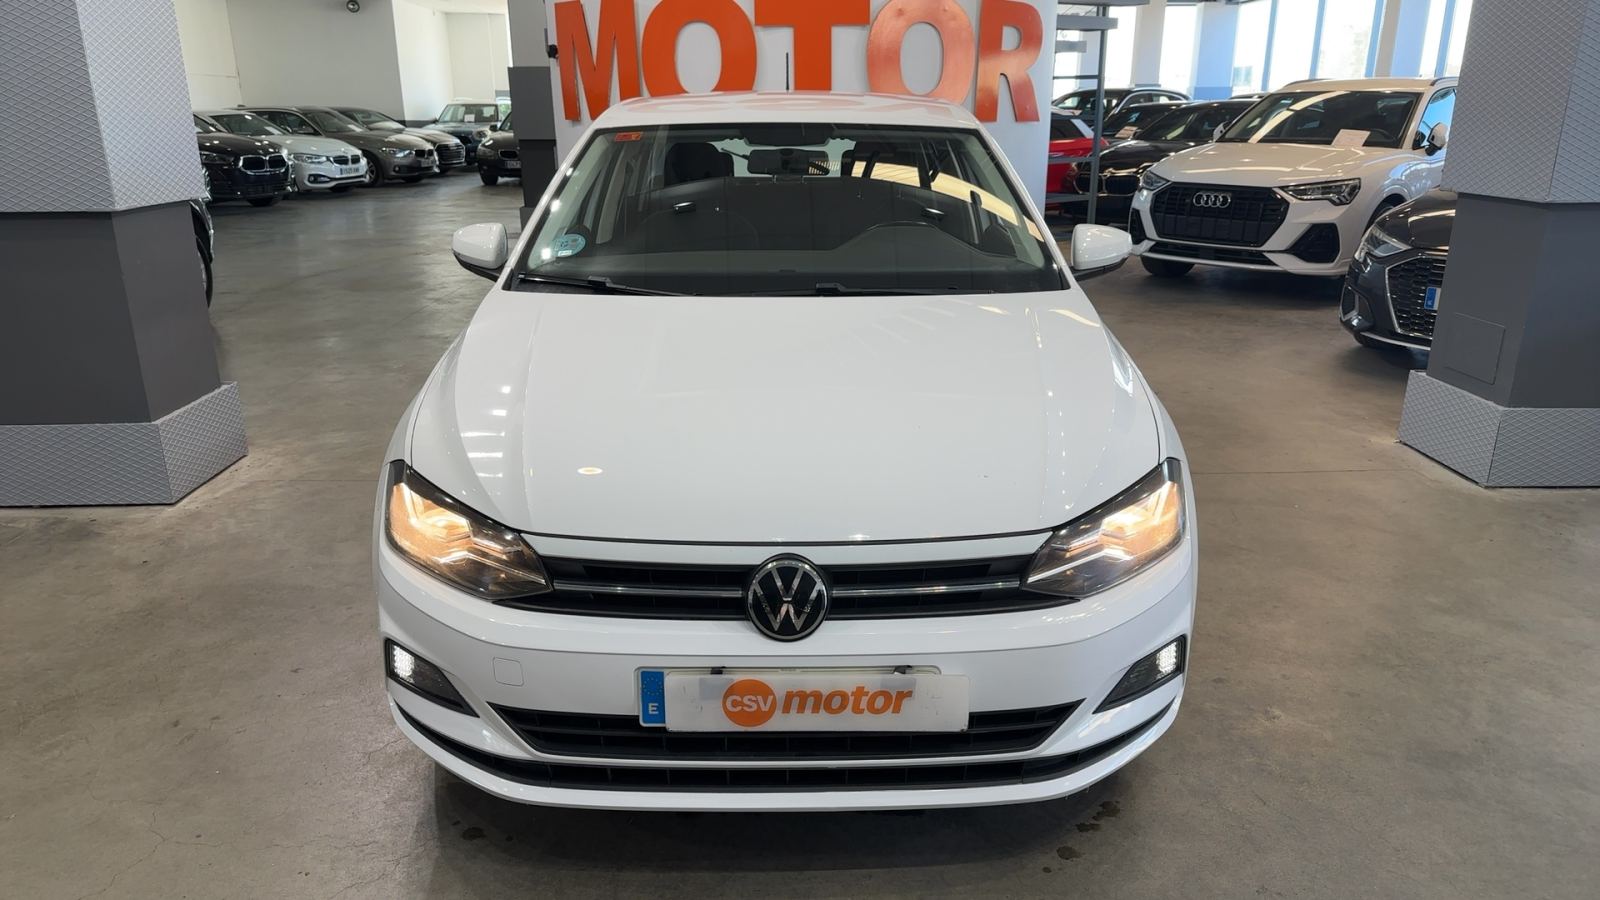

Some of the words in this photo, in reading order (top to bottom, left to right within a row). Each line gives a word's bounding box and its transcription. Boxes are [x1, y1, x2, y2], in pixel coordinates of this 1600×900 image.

[554, 0, 1043, 122] MOTOR
[648, 703, 659, 715] E
[725, 695, 774, 712] CSV
[781, 686, 913, 715] motor
